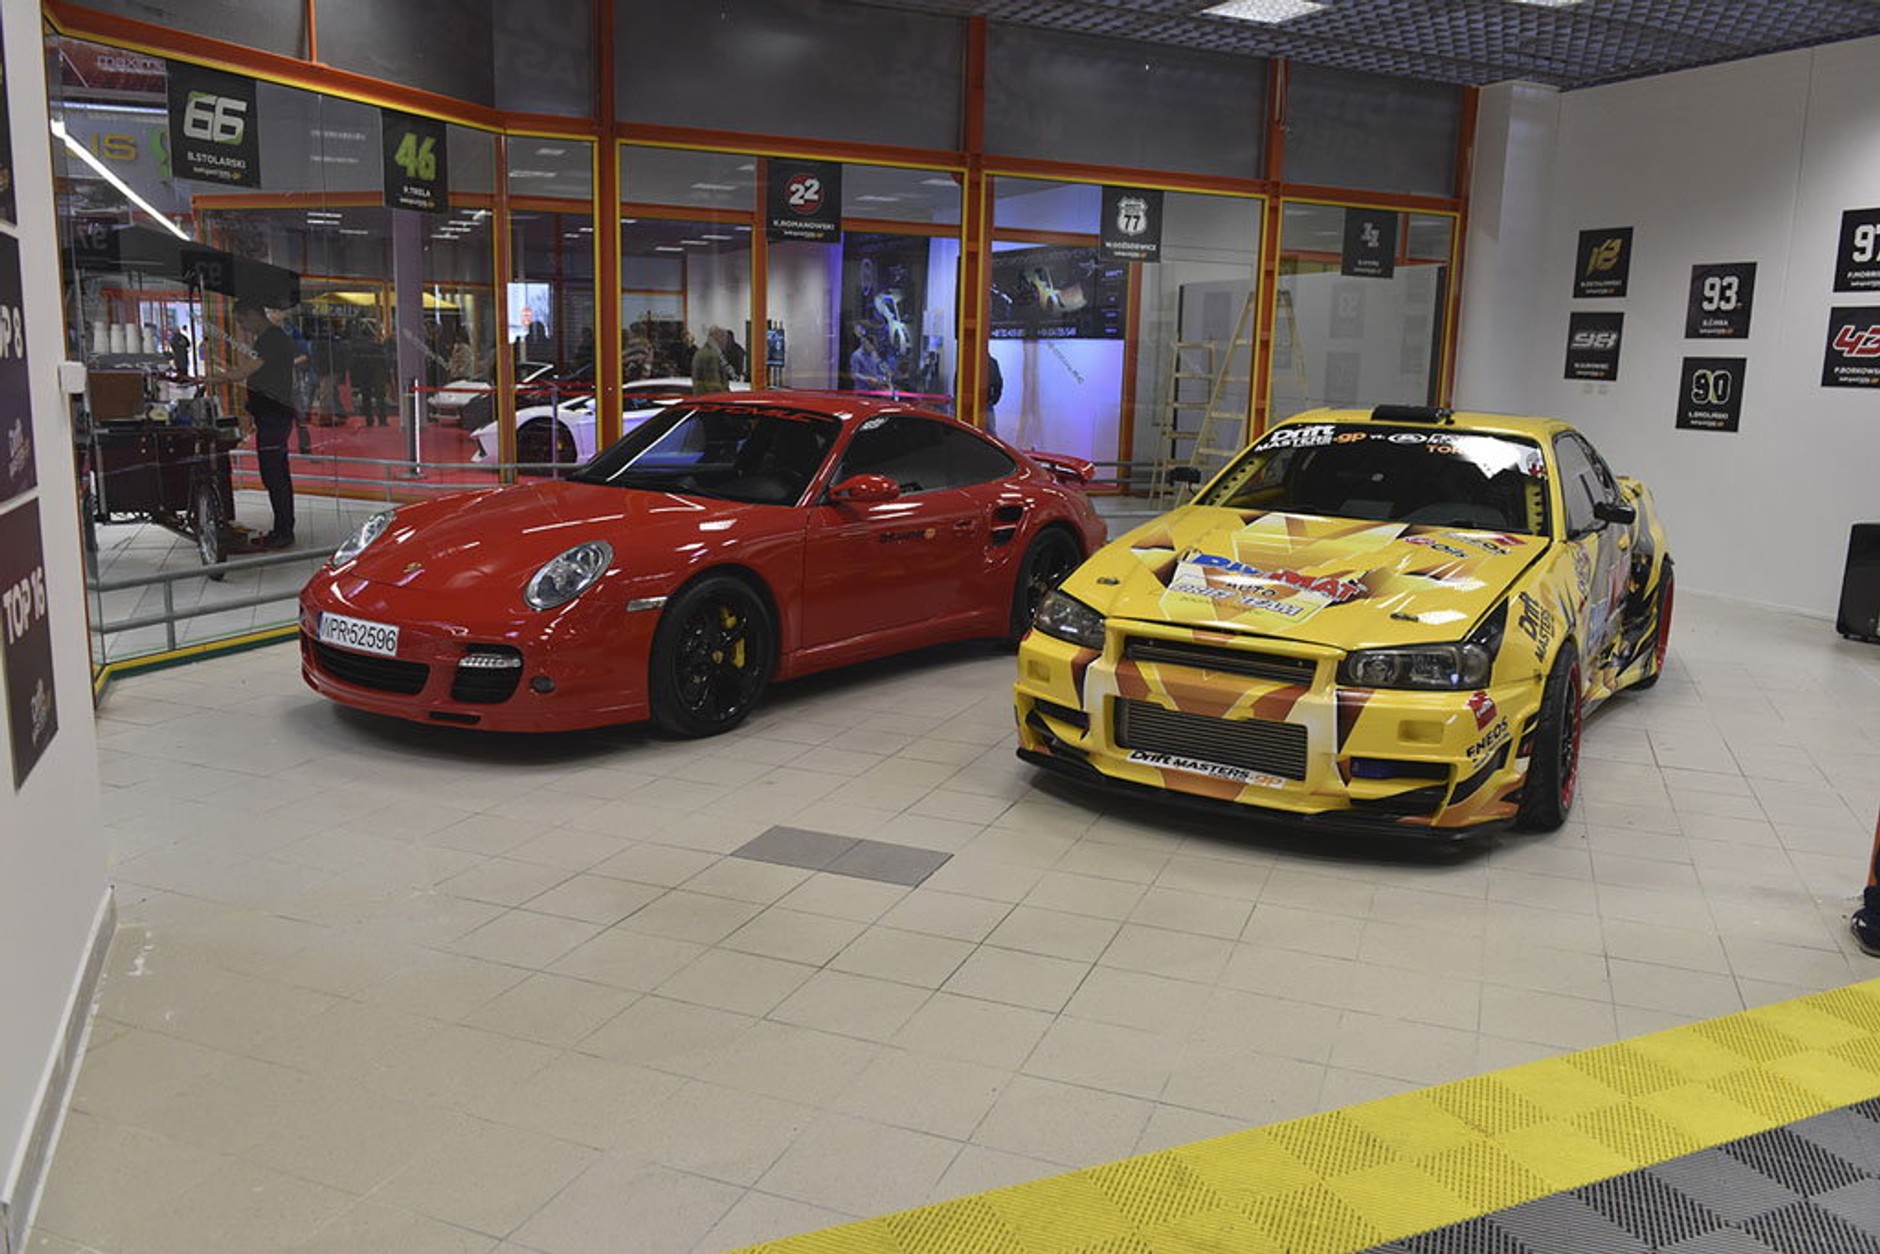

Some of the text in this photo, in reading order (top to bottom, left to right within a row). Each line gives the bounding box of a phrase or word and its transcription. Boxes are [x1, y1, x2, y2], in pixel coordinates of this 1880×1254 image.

[183, 90, 248, 146] 66
[394, 131, 437, 181] 46
[789, 178, 820, 206] 22
[1124, 214, 1141, 231] 77
[1852, 223, 1880, 262] 9
[1702, 275, 1740, 312] 93
[1691, 368, 1732, 405] 90
[2, 565, 46, 645] TOP 16
[349, 622, 397, 652] 52596
[1465, 715, 1508, 762] ENEOS
[1130, 750, 1172, 766] Drift
